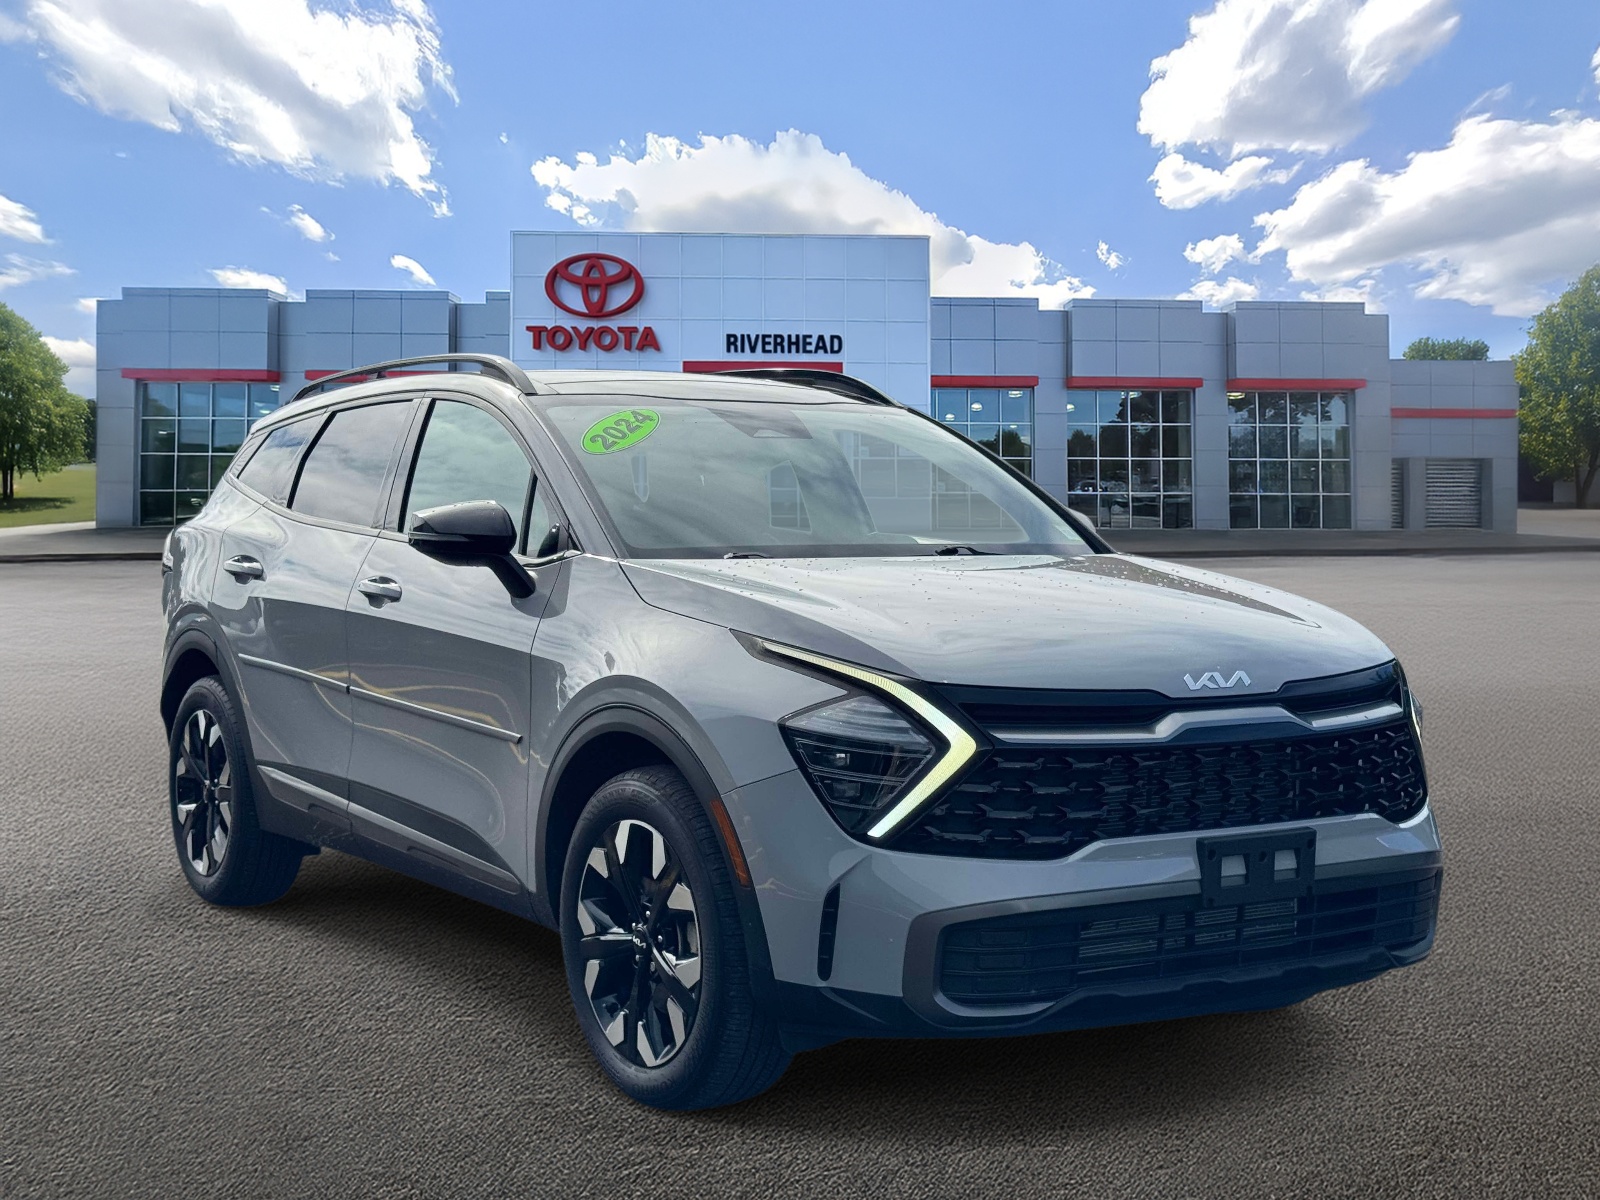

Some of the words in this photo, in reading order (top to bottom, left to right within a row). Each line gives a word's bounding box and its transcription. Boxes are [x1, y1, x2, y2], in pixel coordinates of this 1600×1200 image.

[526, 326, 660, 351] TOYOTA
[726, 333, 843, 354] RIVERHEAD
[590, 410, 656, 450] 2024
[1183, 670, 1251, 691] KIA
